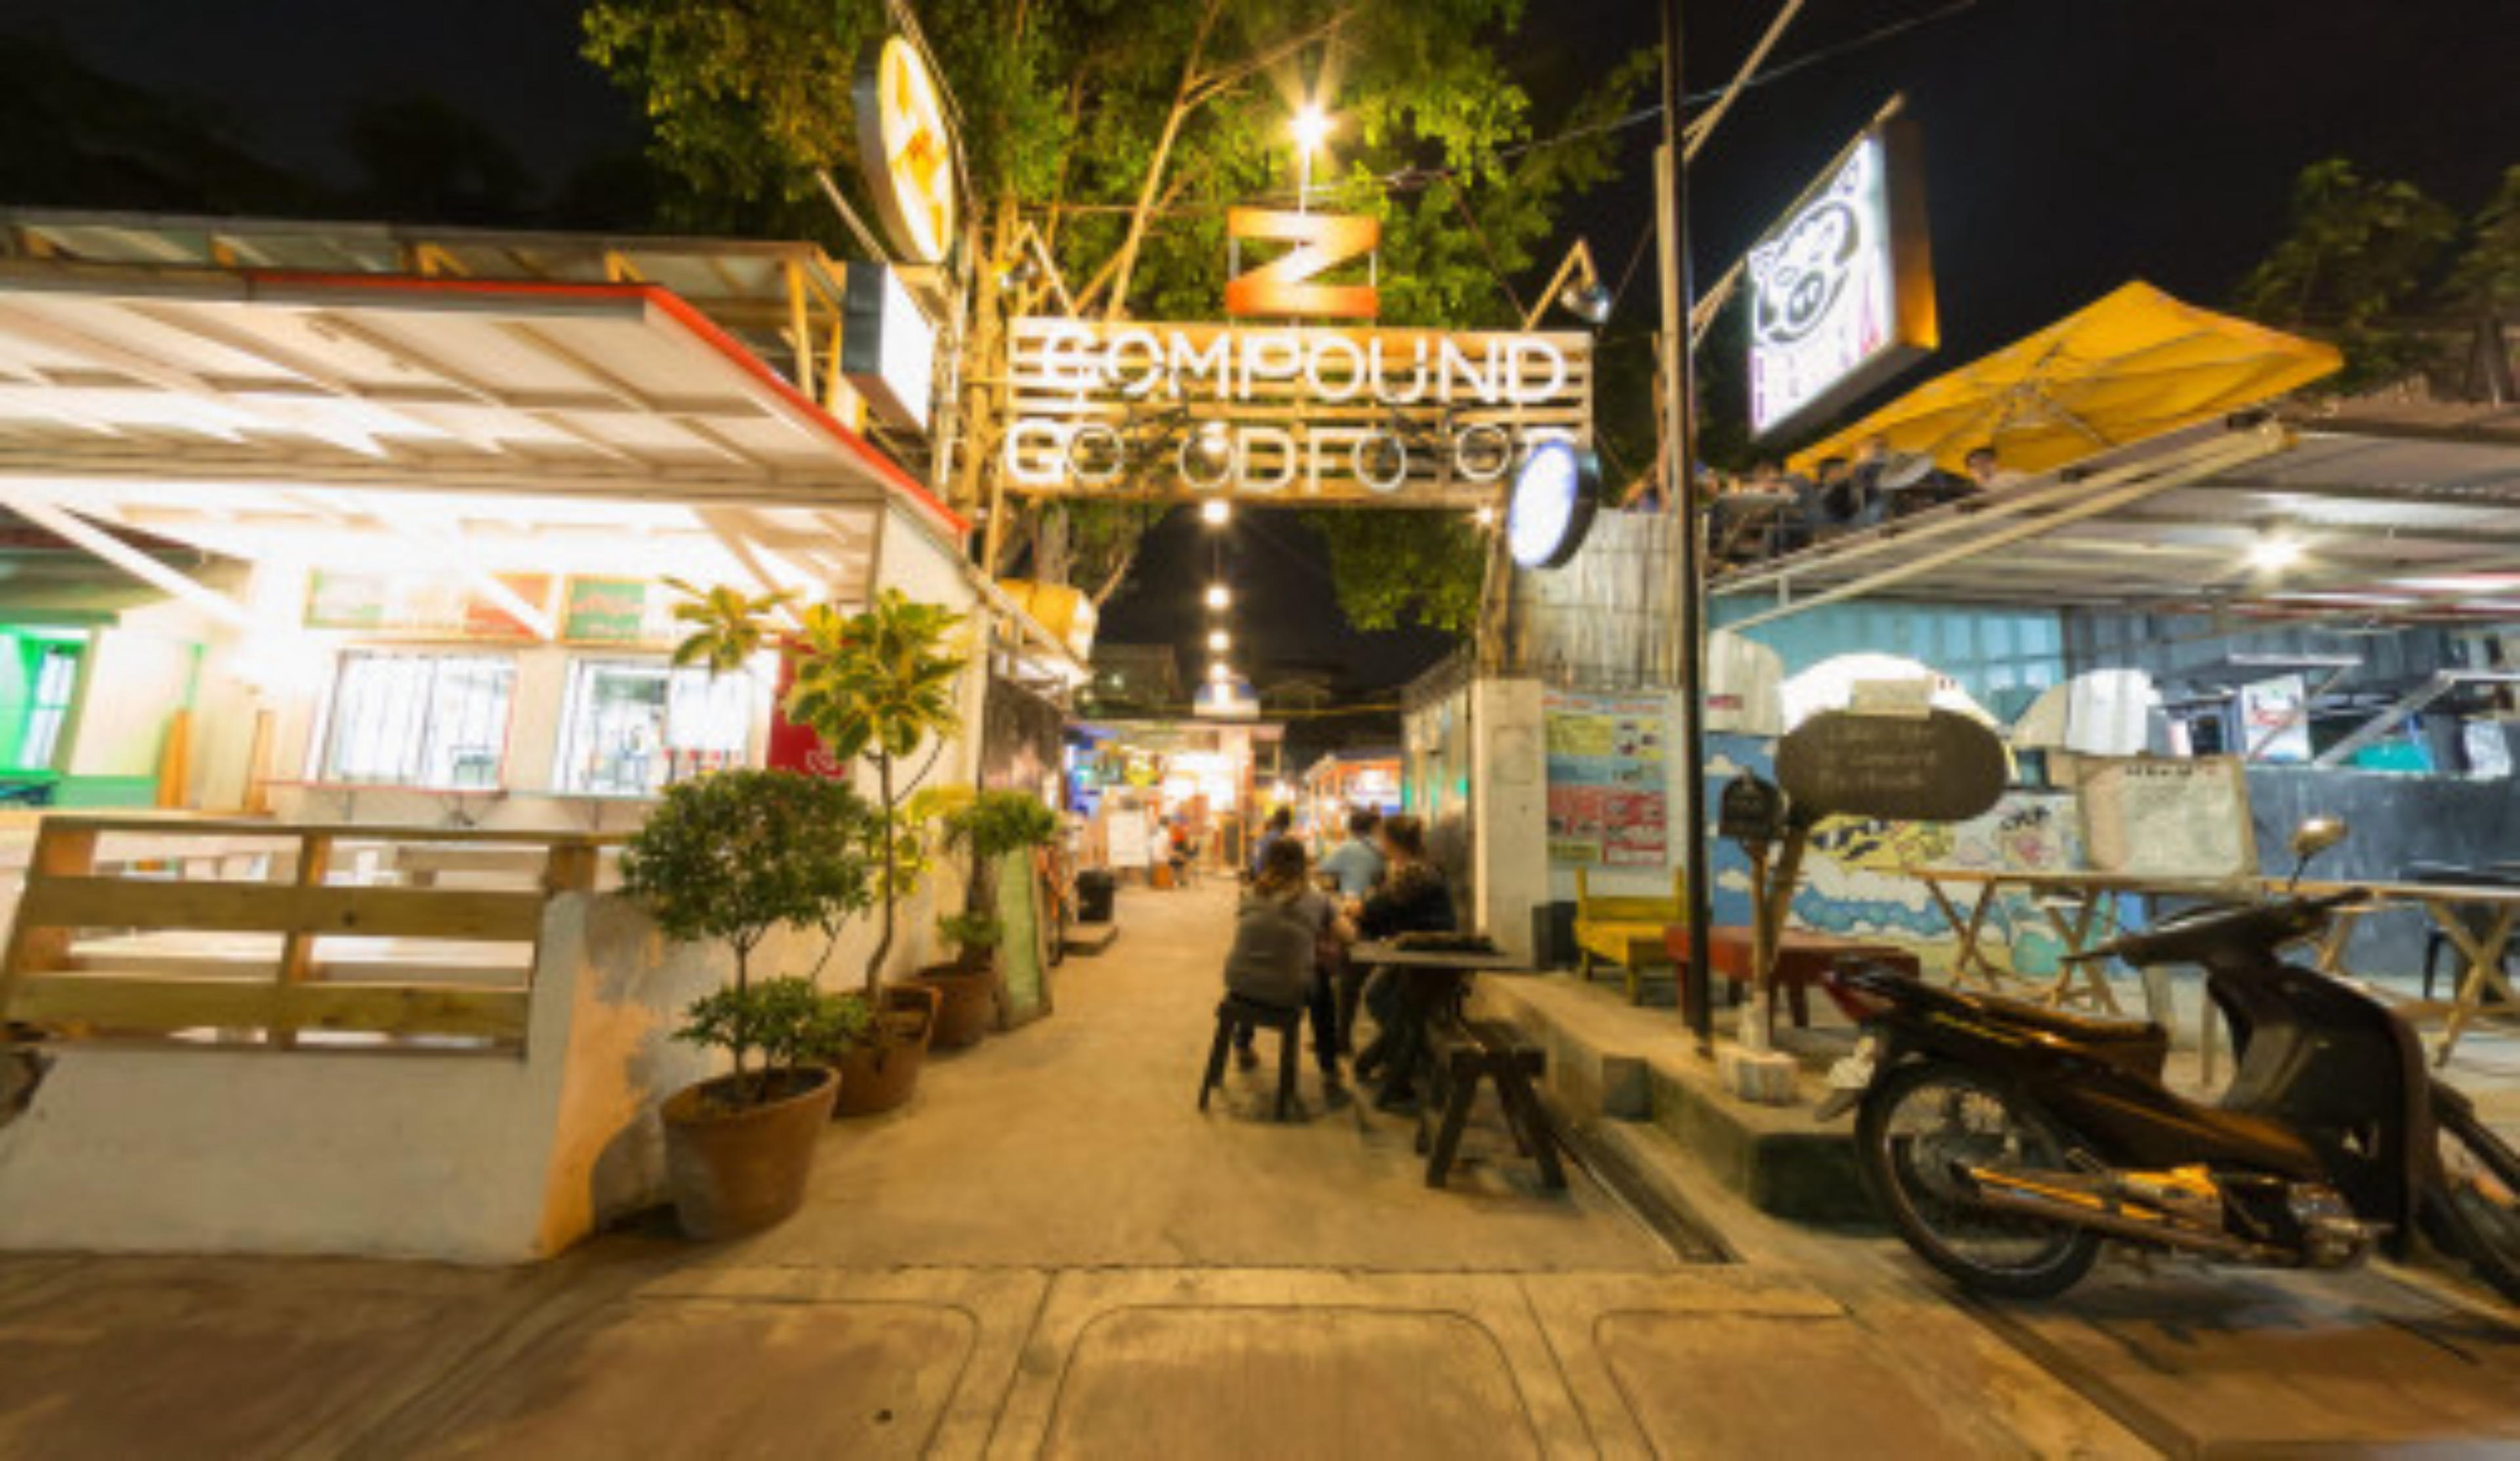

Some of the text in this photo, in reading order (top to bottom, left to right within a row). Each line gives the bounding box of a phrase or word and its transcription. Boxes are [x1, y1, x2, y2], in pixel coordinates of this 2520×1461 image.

[1226, 205, 1380, 318] Z
[1042, 325, 1567, 403] COMPOUND
[1308, 423, 1576, 494] FOO
